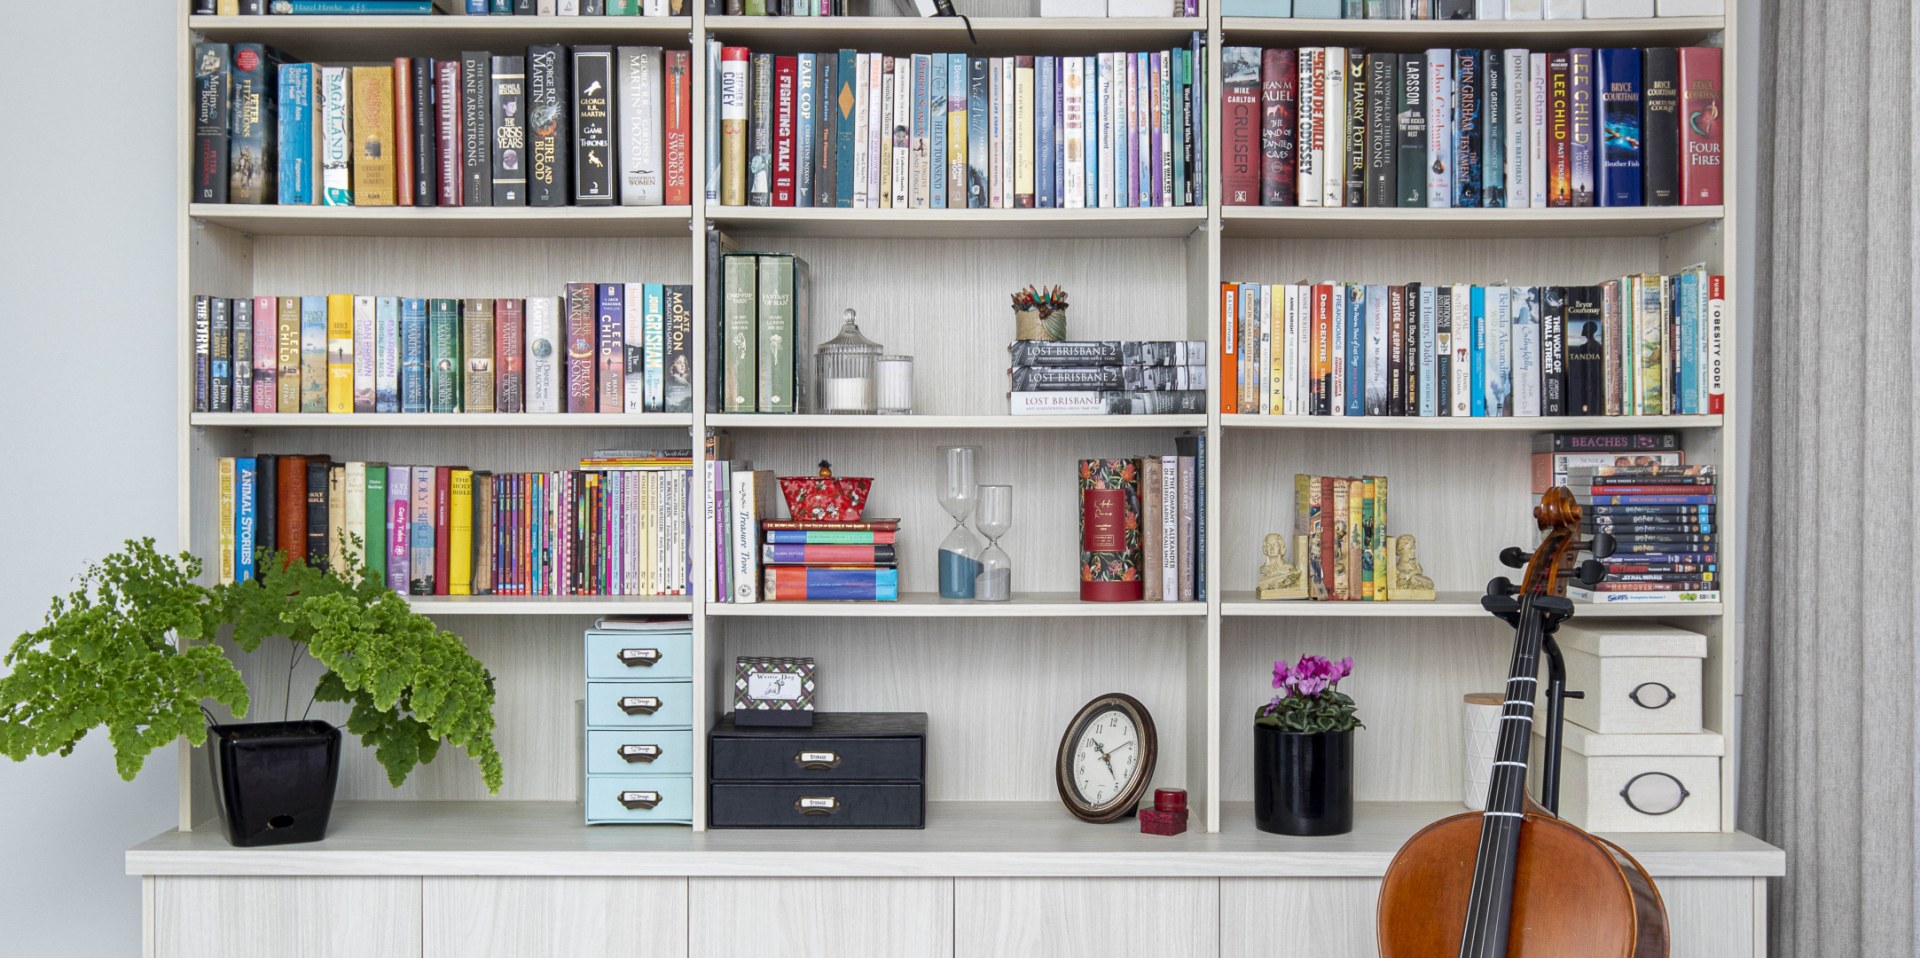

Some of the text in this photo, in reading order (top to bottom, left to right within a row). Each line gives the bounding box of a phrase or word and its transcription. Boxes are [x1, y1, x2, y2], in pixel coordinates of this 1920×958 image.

[533, 54, 546, 103] MARTIN
[630, 55, 641, 107] MARTIN
[1406, 61, 1419, 104] LARSSON
[1513, 55, 1522, 80] JOHN
[1554, 74, 1565, 97] LEE
[208, 75, 220, 108] Mutiny
[723, 72, 735, 106] COVEY
[801, 60, 811, 119] FAIR COP
[917, 60, 927, 137] PATRICIA SCANLAN
[1228, 96, 1255, 104] CARLTON
[1262, 90, 1293, 102] AUEL
[1460, 55, 1473, 131] JOHN GRISHAM
[1514, 82, 1522, 124] GRISHAM
[1574, 54, 1589, 144] LEE CHILD
[1603, 92, 1639, 101] COURTENAY
[1611, 83, 1632, 91] BRYCE
[243, 80, 252, 138] FITZSIMONS
[250, 94, 260, 123] PETER
[467, 60, 477, 166] DIANE ARMSTRONG
[477, 63, 485, 162] THE VOYAGE OF THEIR LIFE
[778, 76, 791, 172] FIGHTING TALK
[884, 112, 892, 135] Silence
[1300, 51, 1313, 175] THE TALBOT ODYSSEY
[1312, 99, 1324, 114] DE
[1374, 61, 1384, 168] DIANE ARMSTRONG
[1554, 100, 1566, 140] CHILD
[497, 127, 522, 137] CRISIS
[498, 137, 523, 148] YEARS
[580, 138, 608, 147] THRONES
[631, 116, 642, 169] DOZOIS
[1234, 105, 1248, 173] CRUISER
[1312, 116, 1324, 150] MILLE
[1352, 82, 1366, 170] HARRY POTTER
[535, 141, 545, 179] BLOOD
[545, 136, 554, 163] FIRE
[668, 132, 679, 186] SWORDS
[934, 121, 943, 189] HELEN TOWNSEND
[1460, 135, 1470, 183] TESTAMENT
[1690, 141, 1720, 152] FOUR
[1692, 154, 1719, 165] FIRES
[678, 176, 685, 187] OF
[197, 300, 208, 354] THE FIRM
[570, 289, 583, 336] MARTIN
[673, 292, 683, 350] MORTON
[280, 324, 289, 361] CHILD
[290, 332, 298, 354] LEE
[602, 315, 611, 355] CHILD
[611, 322, 621, 347] LEE
[646, 314, 662, 368] GRISHAM
[1027, 347, 1116, 355] LOST BRISBANE 2
[1553, 316, 1561, 373] THE WOLF OF
[1713, 311, 1721, 356] OBESITY
[1544, 341, 1553, 374] STREET
[264, 377, 272, 408] KILLING
[571, 360, 580, 397] SONGS
[1029, 373, 1117, 382] LOST BRISBANE 2
[1025, 397, 1100, 405] LOST BRISBANE
[1572, 437, 1628, 447] BEACHES
[242, 469, 252, 565] ANIMAL STORIES
[739, 512, 750, 574] Treasure Trove
[1095, 725, 1103, 734] 11
[1110, 718, 1118, 727] 12
